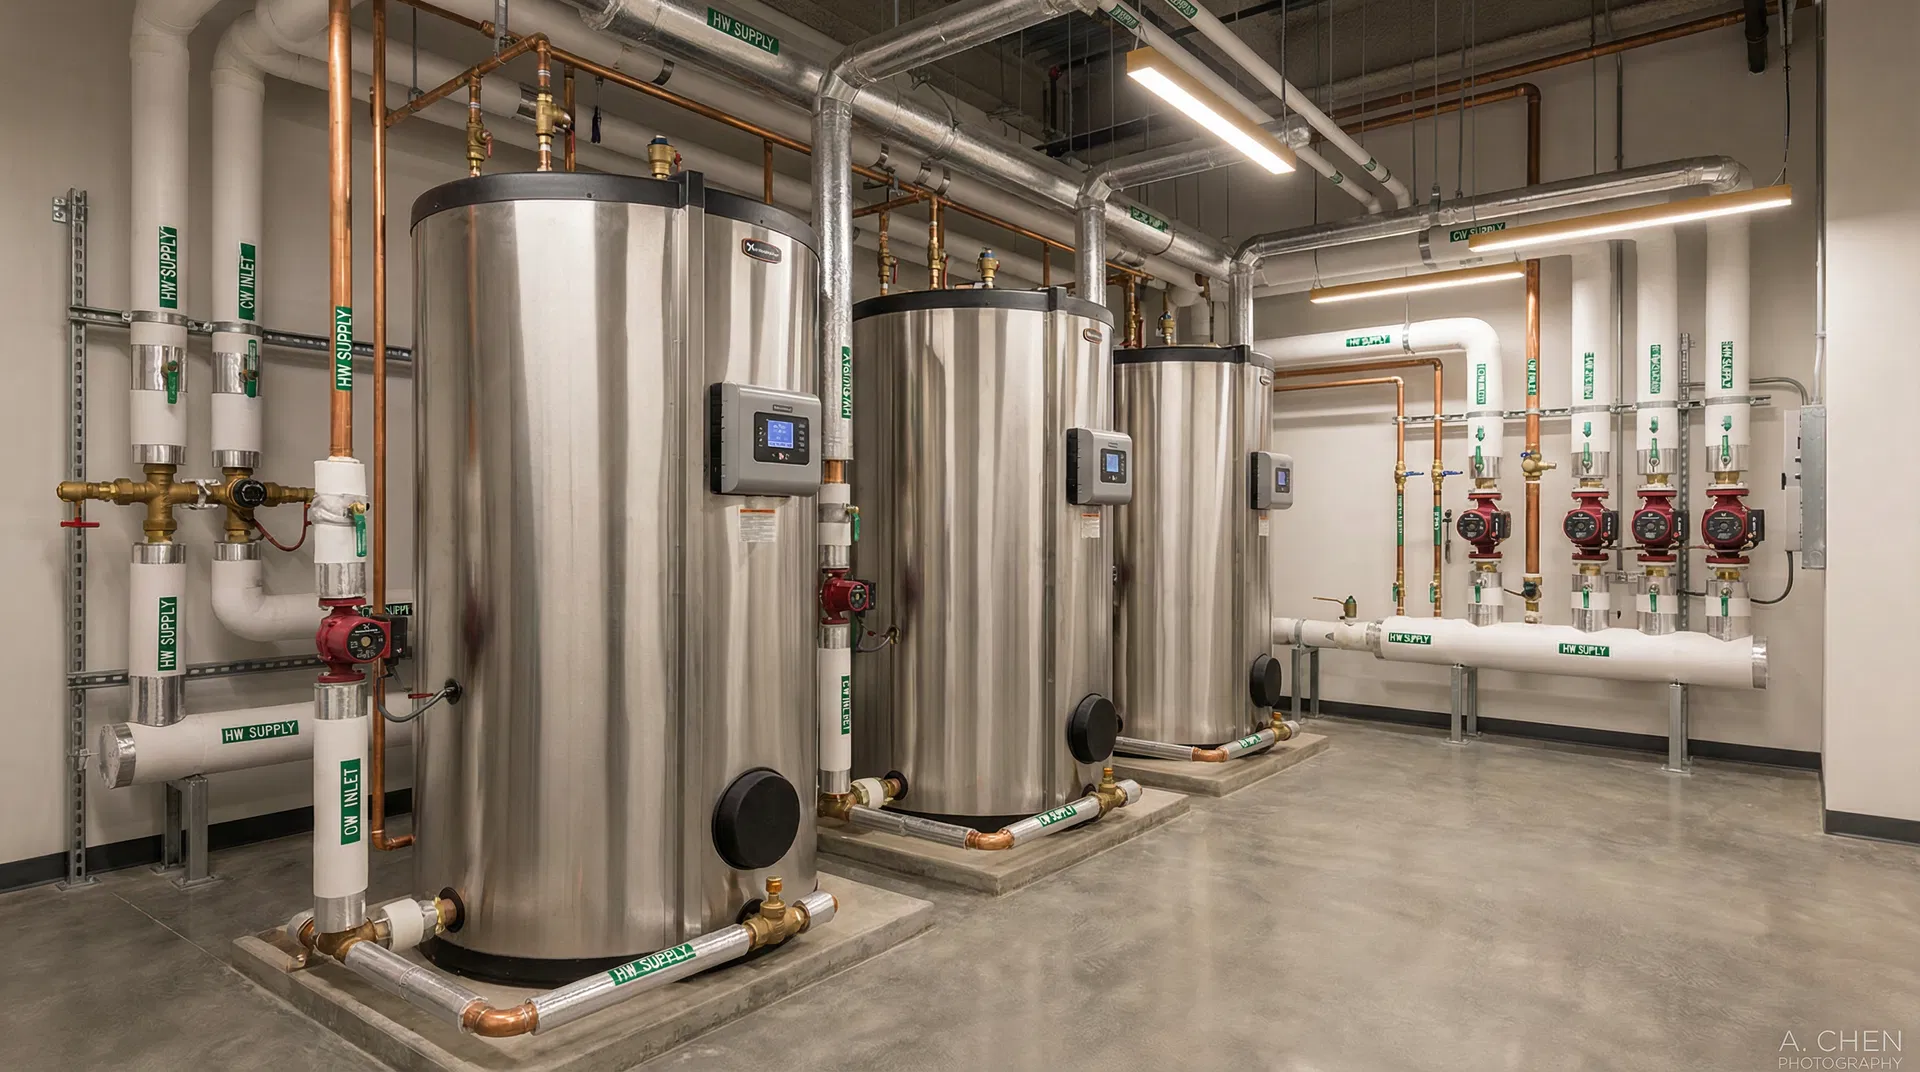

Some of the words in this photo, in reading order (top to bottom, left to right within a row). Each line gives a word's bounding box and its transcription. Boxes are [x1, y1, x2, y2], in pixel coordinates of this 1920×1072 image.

[713, 11, 731, 32] HW
[734, 21, 774, 51] SUPPLY
[160, 230, 177, 278] SUPPLY
[240, 255, 254, 288] INLET
[160, 281, 177, 301] HW
[240, 292, 254, 309] CW
[337, 309, 352, 361] SUPPLY
[337, 365, 352, 387] HW
[160, 600, 175, 645] SUPPLY
[1389, 633, 1403, 642] HW
[1563, 644, 1577, 654] HW
[160, 650, 175, 668] HW
[225, 728, 244, 742] HW
[249, 722, 295, 739] SUPPLY
[344, 768, 358, 808] INLET
[614, 963, 638, 982] HW
[639, 945, 689, 972] SUPPLY
